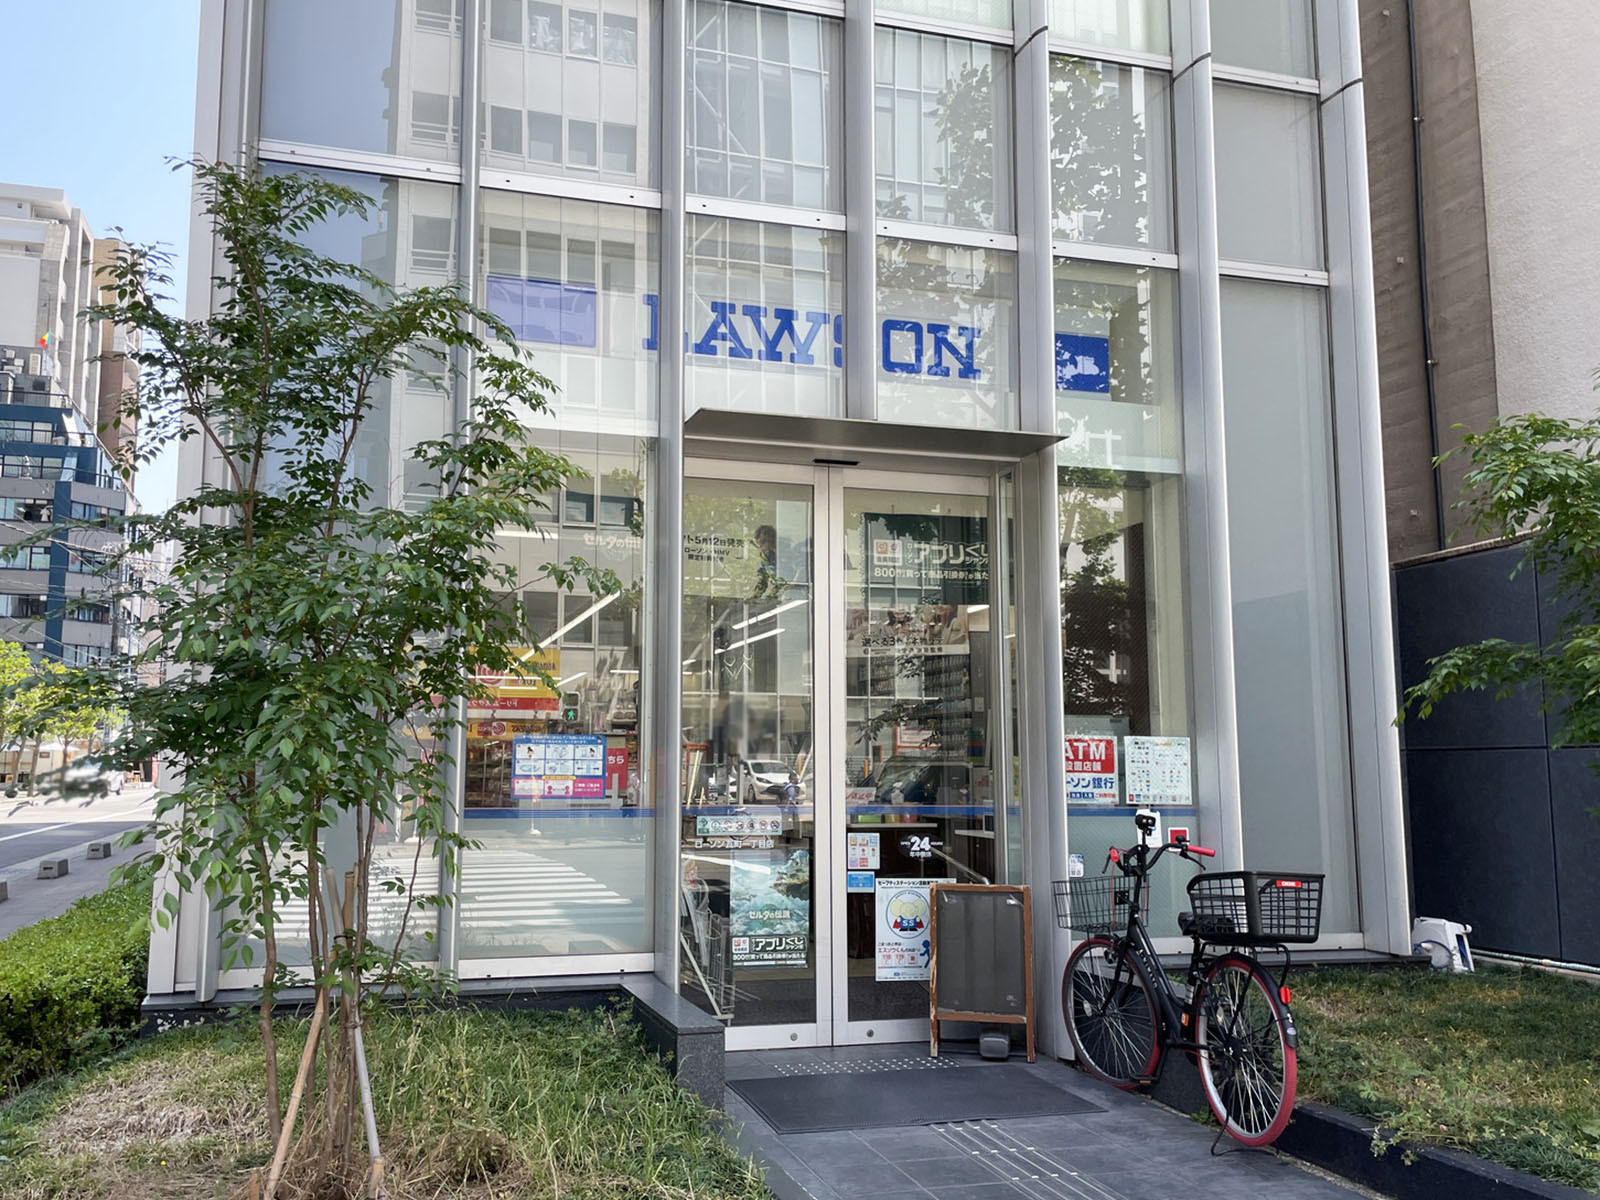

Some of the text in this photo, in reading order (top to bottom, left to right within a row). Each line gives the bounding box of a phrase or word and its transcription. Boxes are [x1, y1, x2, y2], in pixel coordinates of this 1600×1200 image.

[642, 294, 981, 379] LAWON
[683, 535, 745, 548] ト5月12日発売
[1065, 741, 1106, 760] ATM
[910, 836, 931, 851] 24
